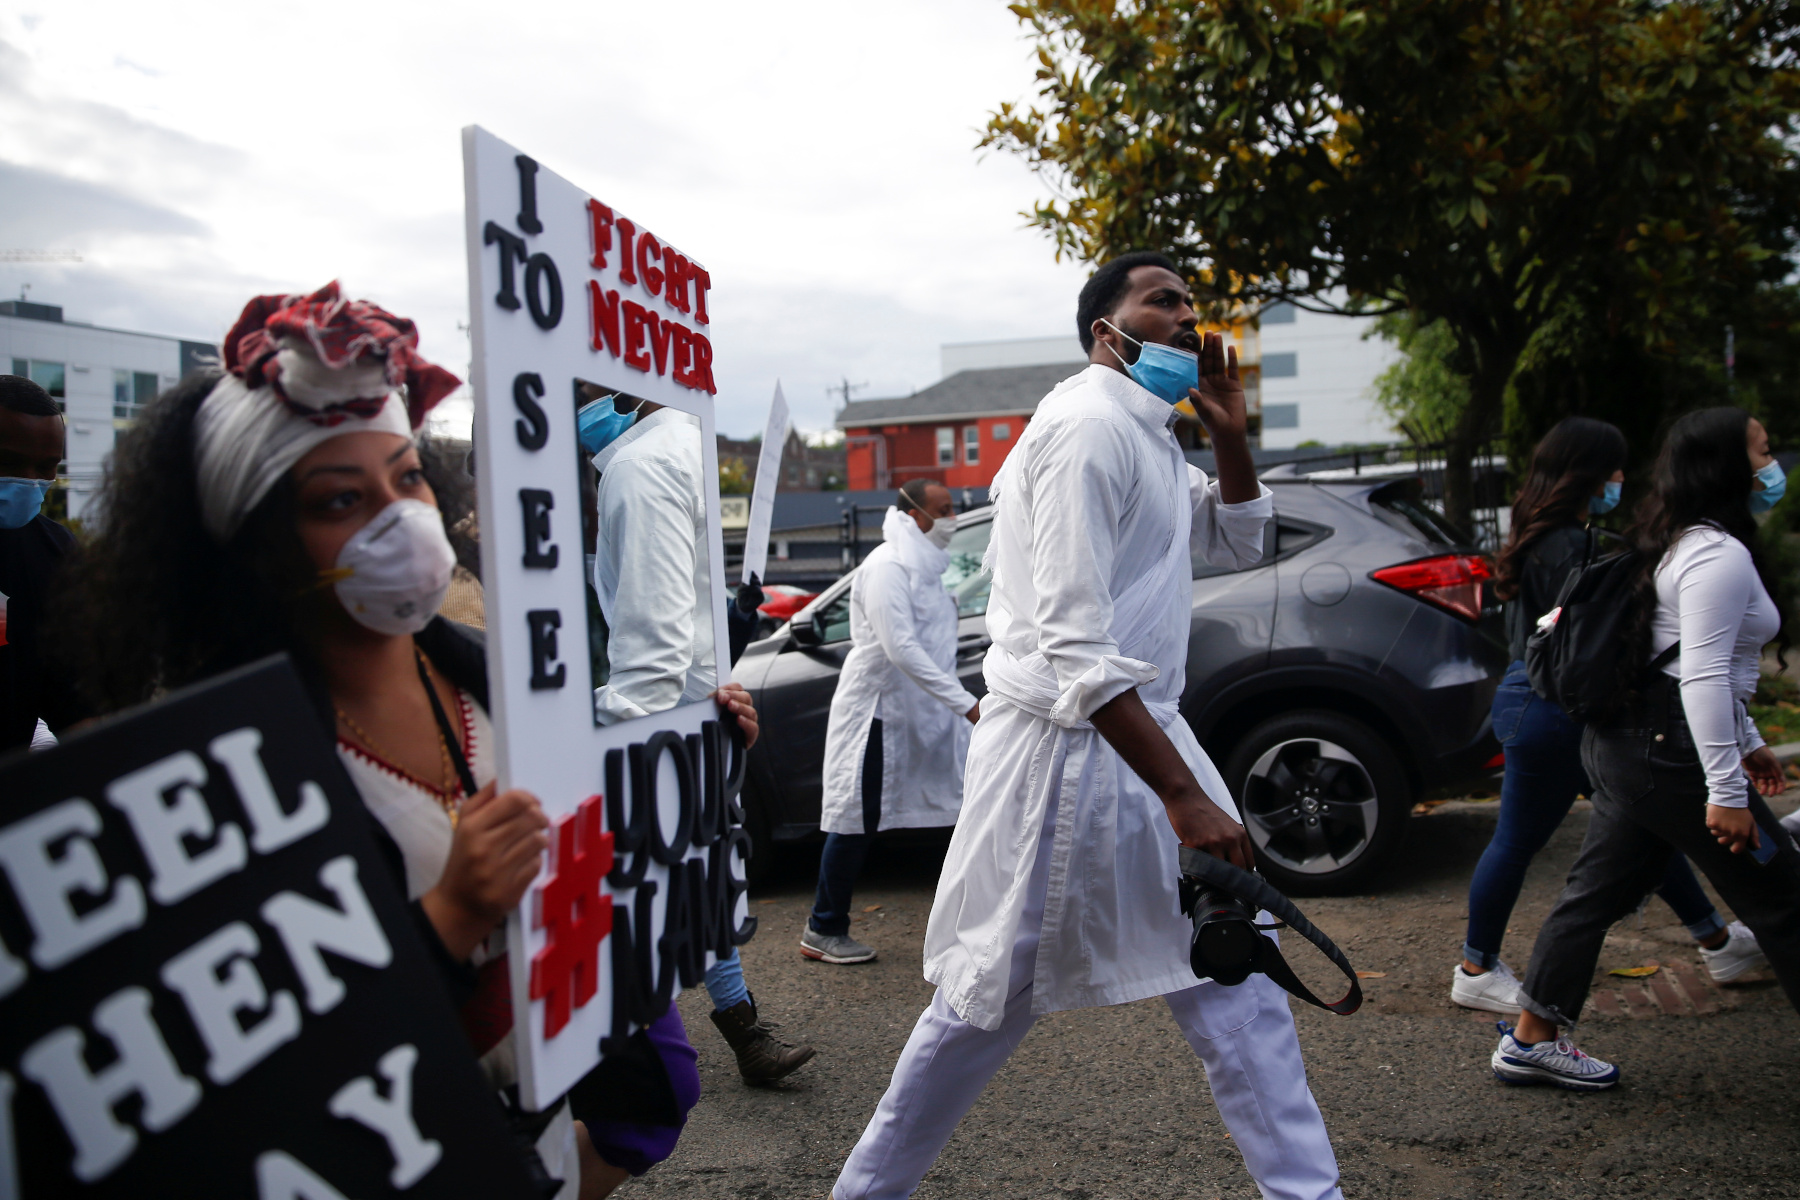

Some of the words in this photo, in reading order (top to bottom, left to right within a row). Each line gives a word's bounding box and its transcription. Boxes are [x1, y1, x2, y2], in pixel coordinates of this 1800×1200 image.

[484, 220, 564, 331] TO
[587, 279, 717, 395] NEVER
[515, 154, 543, 235] I
[586, 198, 711, 325] FIGHT
[0, 727, 330, 995] EEL
[600, 828, 758, 1058] NAME
[0, 855, 393, 1200] HEN
